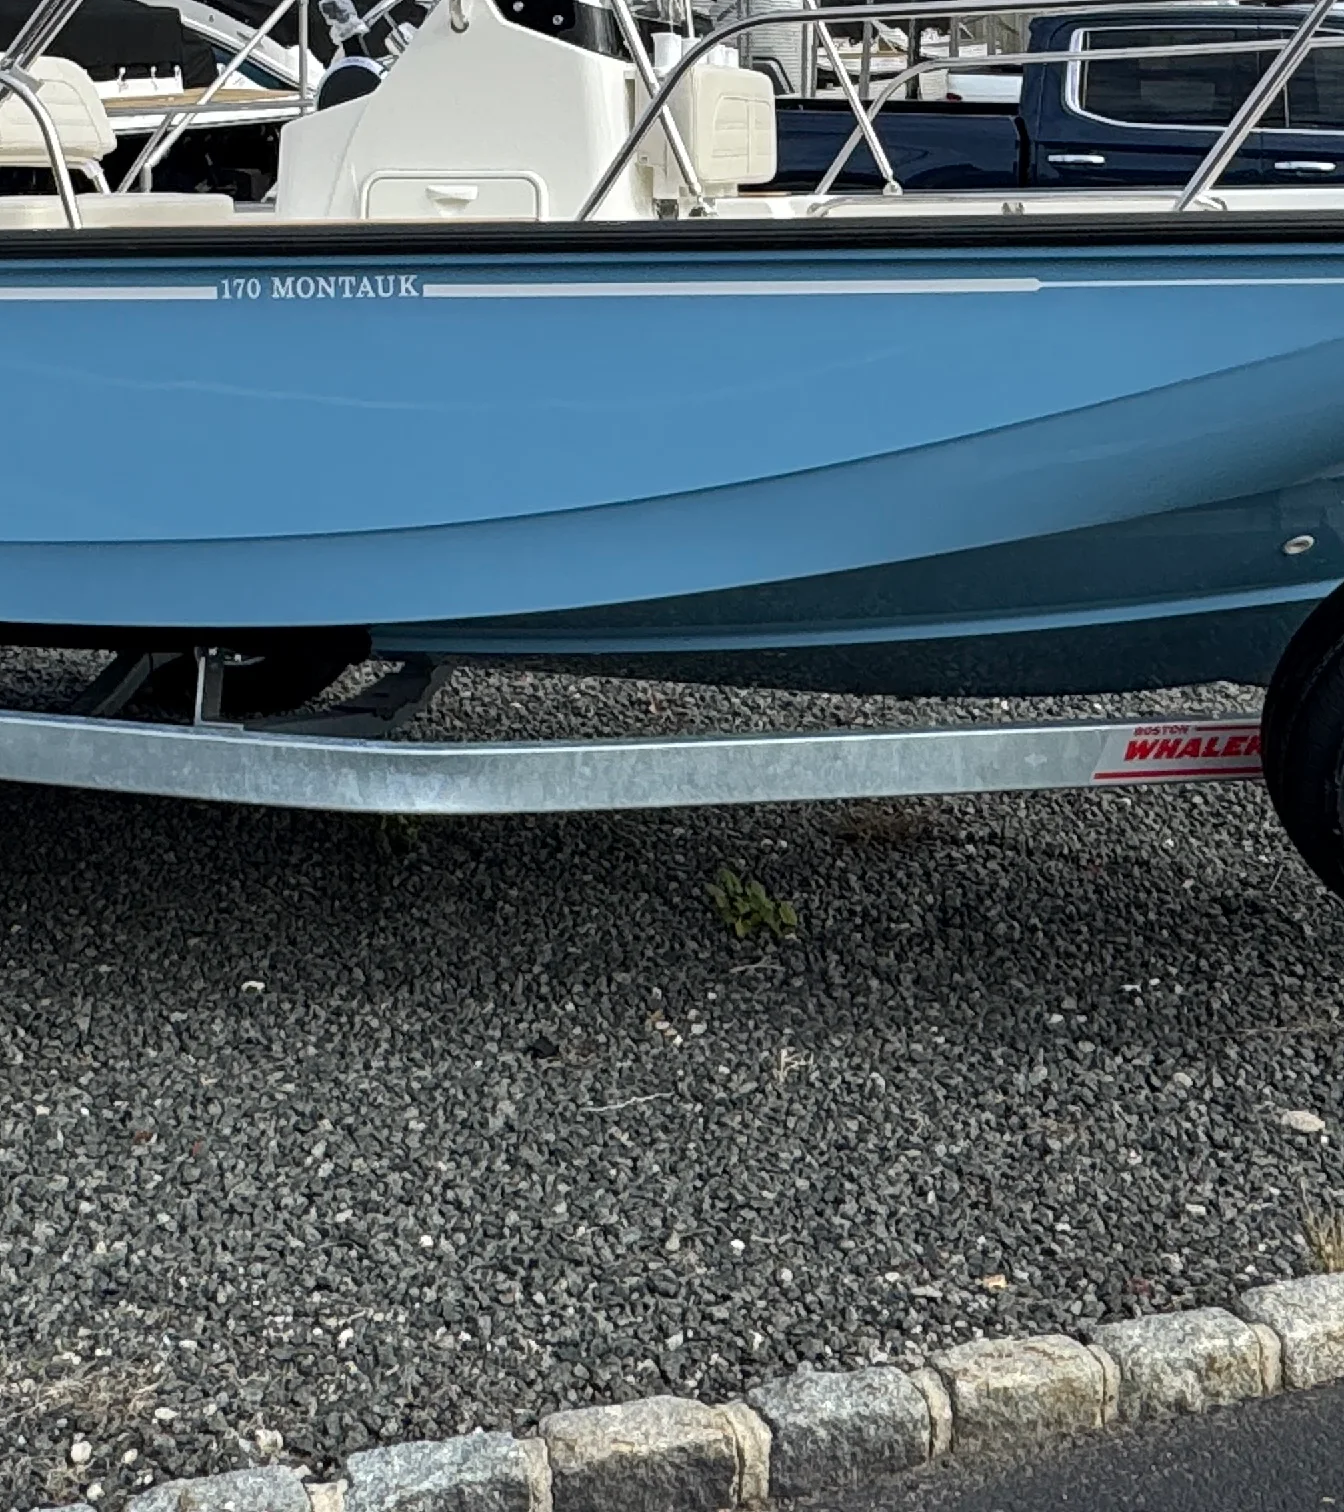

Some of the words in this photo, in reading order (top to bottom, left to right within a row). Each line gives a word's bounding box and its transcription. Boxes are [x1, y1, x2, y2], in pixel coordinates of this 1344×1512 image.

[220, 278, 262, 300] 170
[270, 274, 420, 299] MONTAUK
[1133, 724, 1191, 737] BOSTON
